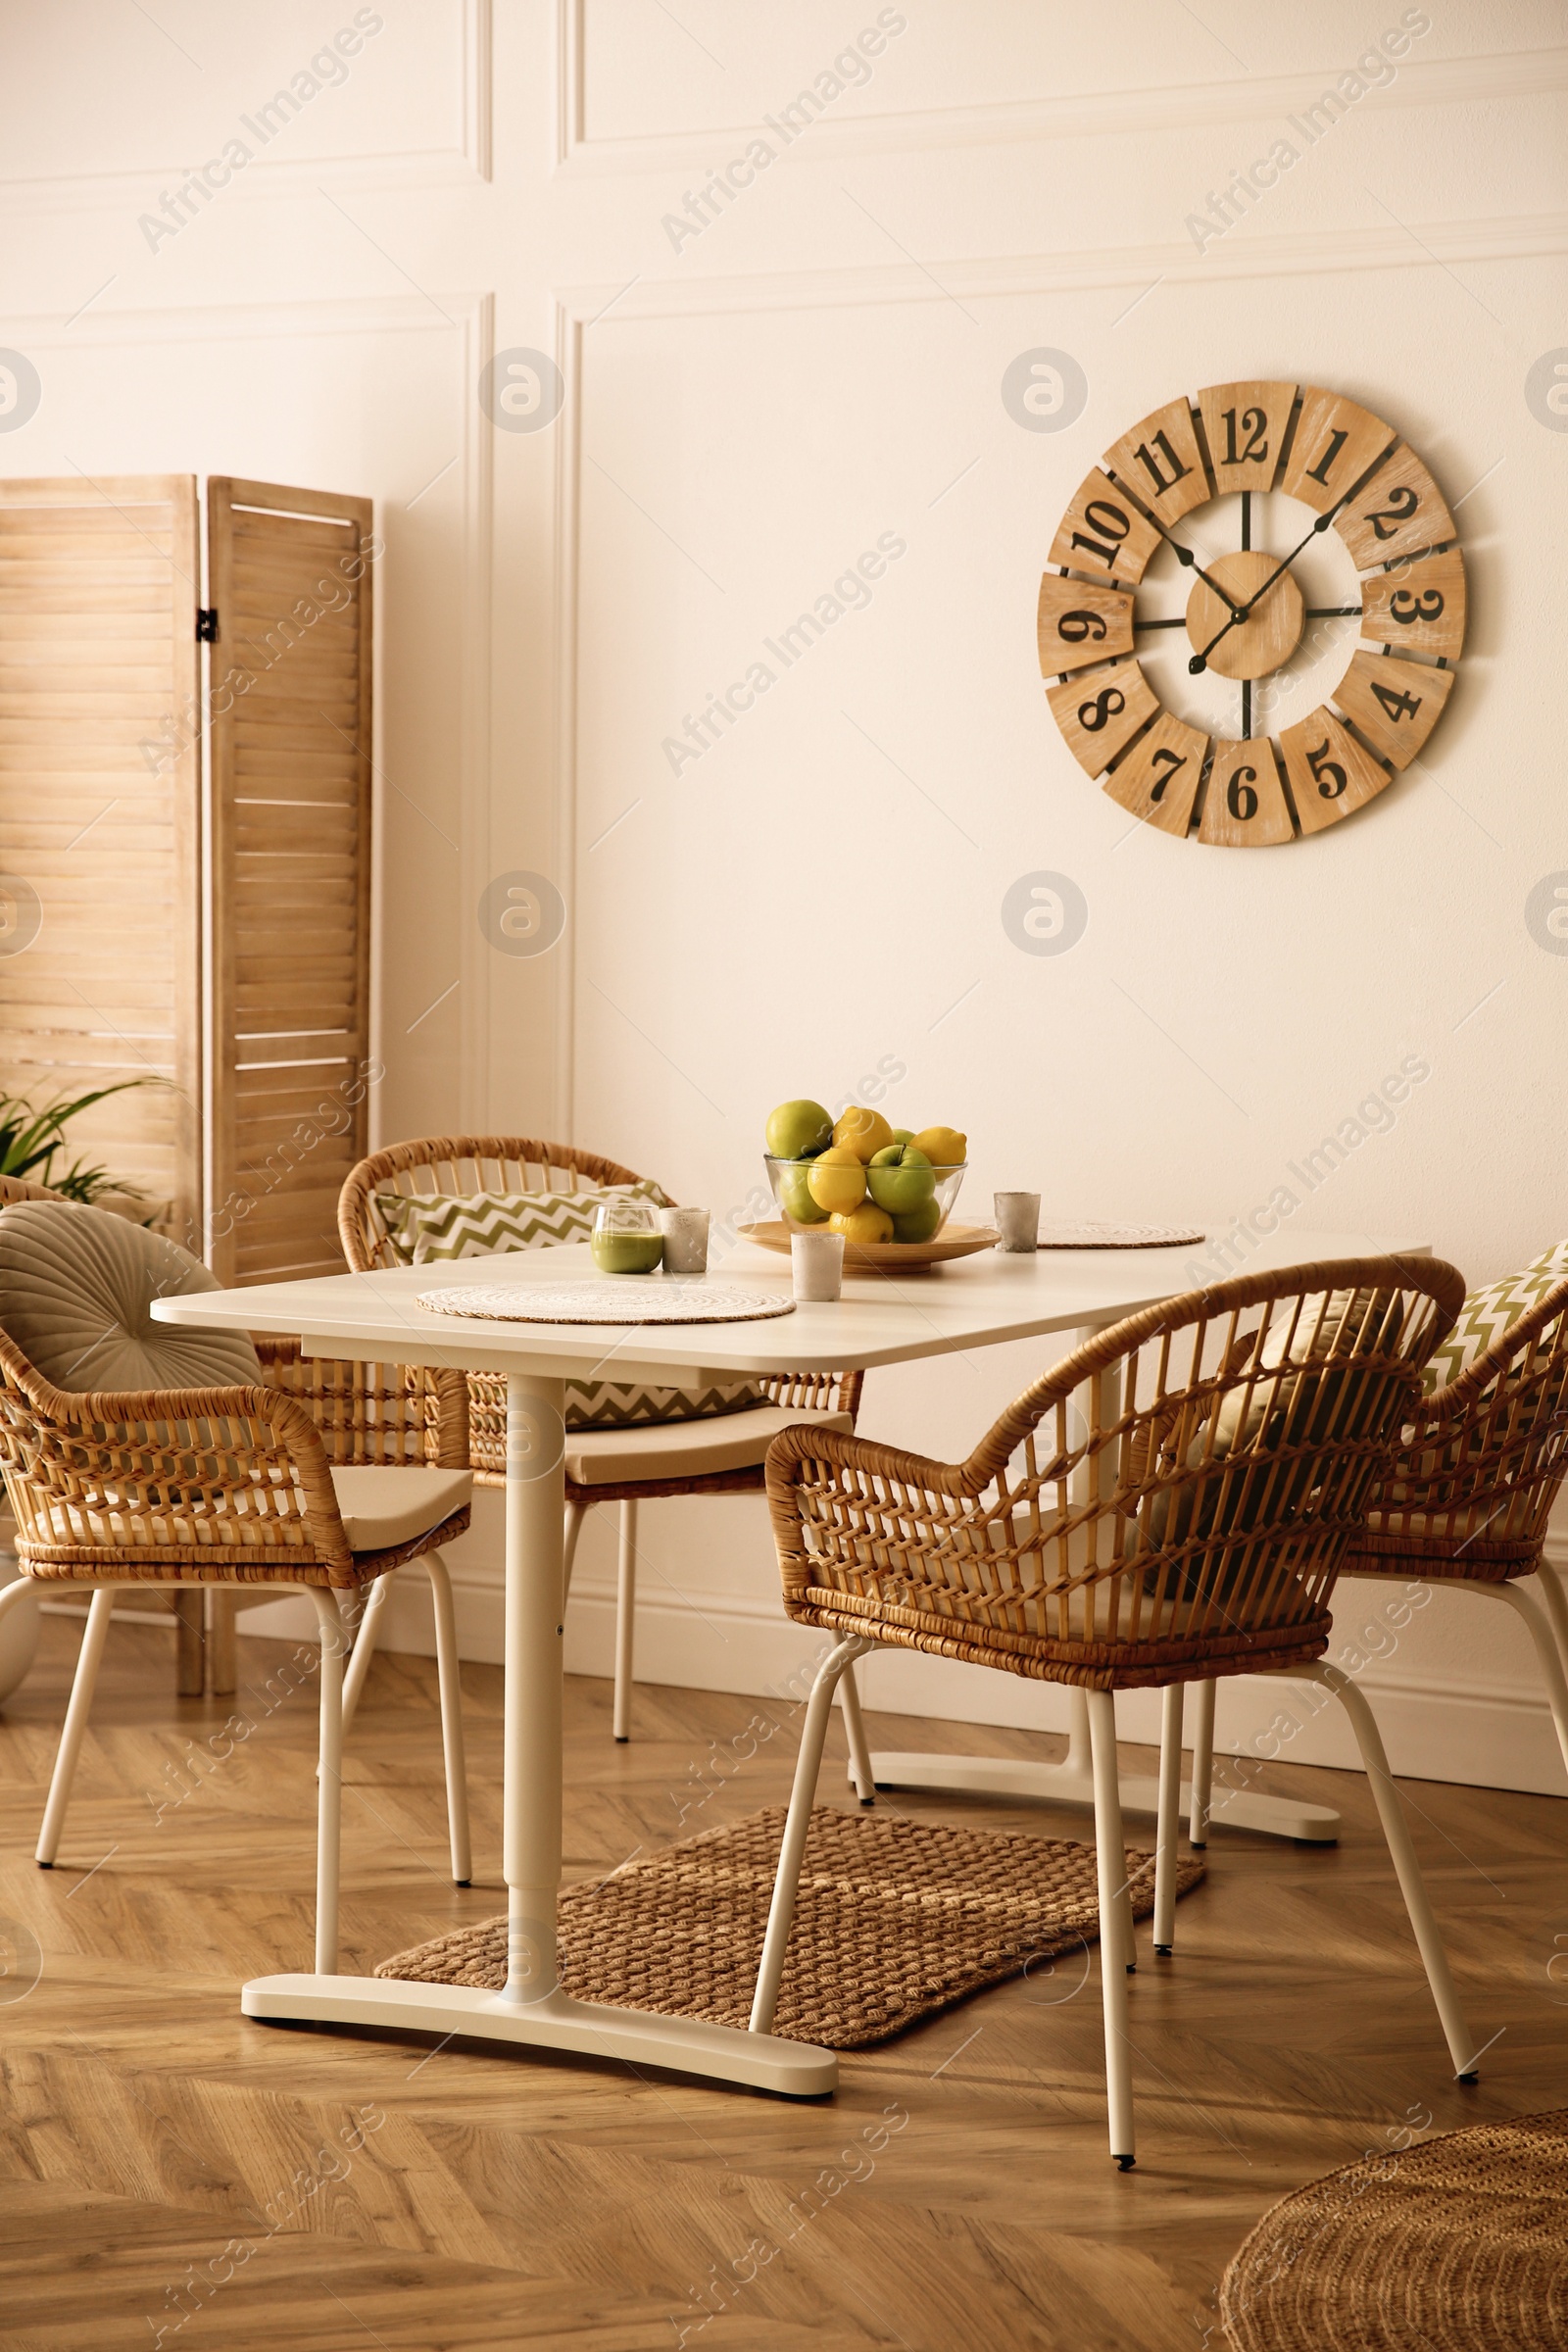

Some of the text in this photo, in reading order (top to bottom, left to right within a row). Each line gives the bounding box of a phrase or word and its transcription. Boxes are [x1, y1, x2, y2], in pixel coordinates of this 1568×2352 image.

[1221, 408, 1267, 465] 12
[1306, 429, 1348, 486] 1
[1134, 430, 1194, 497] 11
[1071, 501, 1130, 569] 10
[1364, 487, 1418, 540] 2
[1058, 610, 1106, 643] 9
[1391, 590, 1445, 624] 3
[1078, 688, 1125, 732] 8
[1370, 682, 1422, 722] 4
[1151, 749, 1187, 802] 7
[1227, 766, 1258, 820] 6
[1305, 739, 1347, 799] 5
